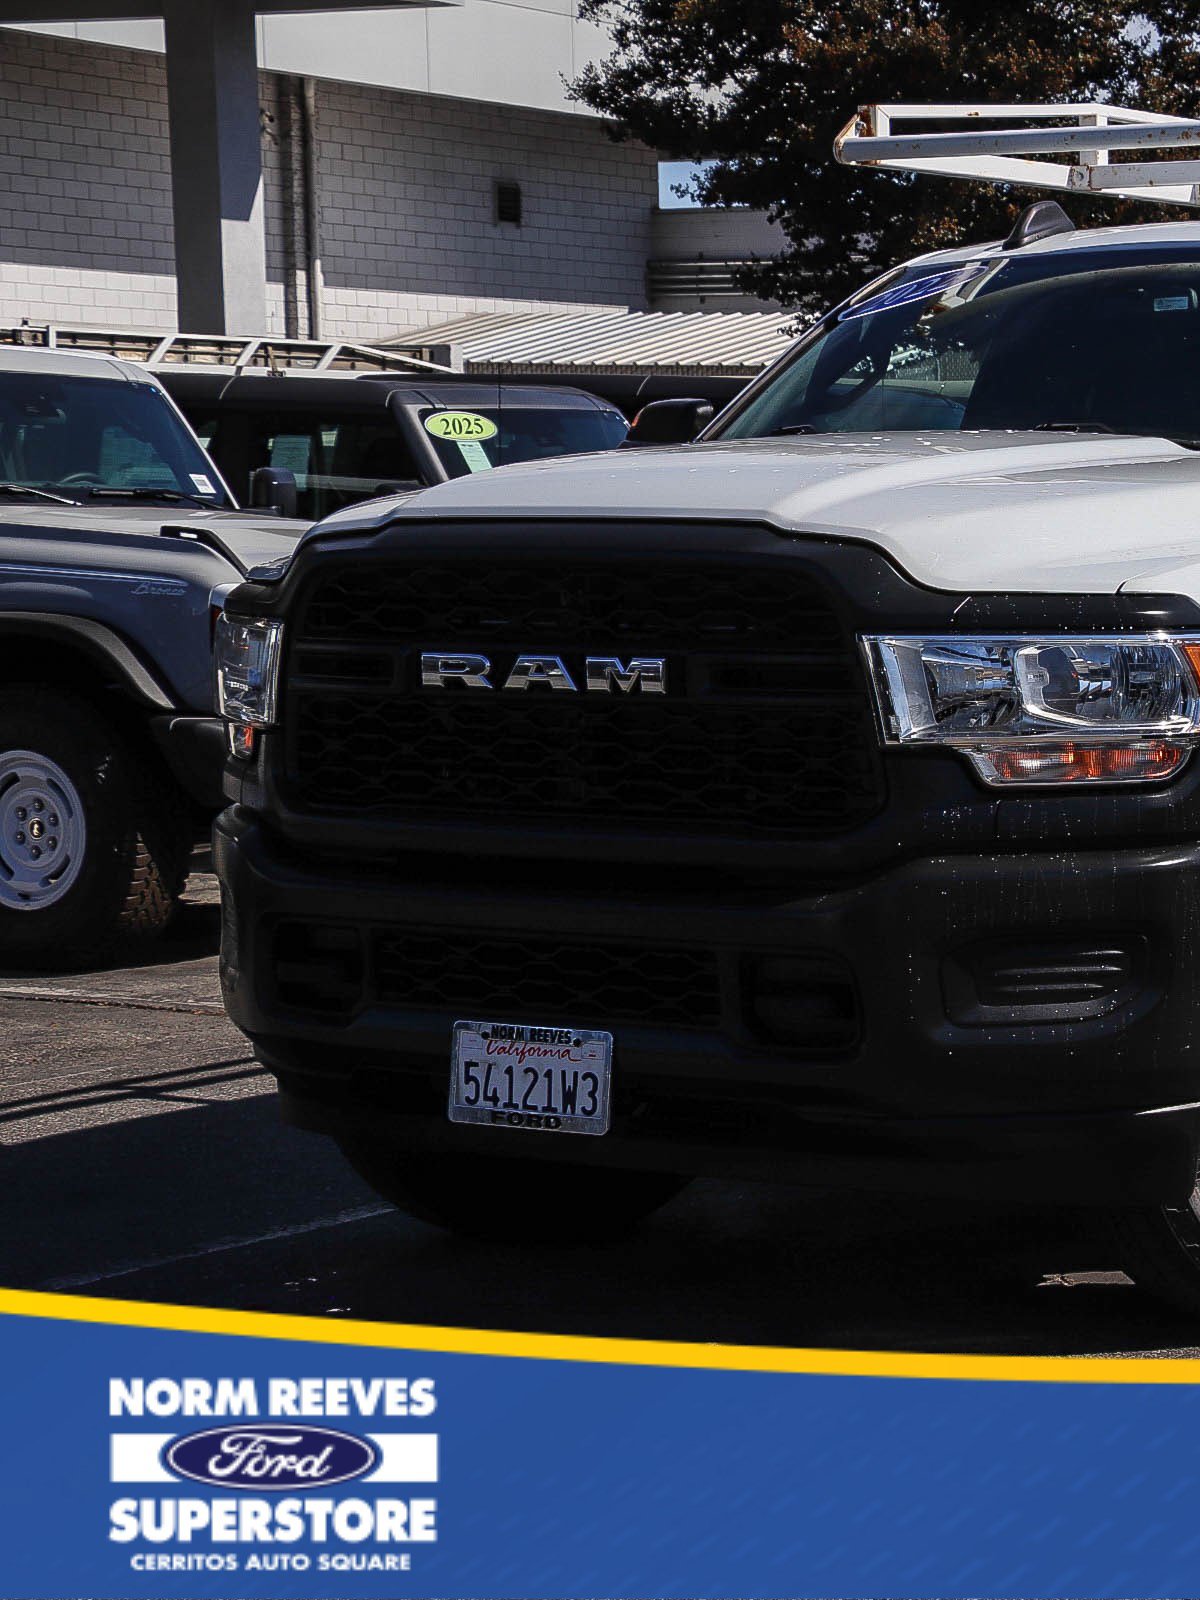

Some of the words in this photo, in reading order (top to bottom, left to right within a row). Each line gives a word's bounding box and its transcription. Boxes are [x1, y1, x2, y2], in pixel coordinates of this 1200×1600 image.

[440, 417, 483, 435] 2025
[421, 652, 666, 694] RAM
[491, 1025, 524, 1040] NORM
[530, 1029, 572, 1044] REEVES
[486, 1040, 582, 1065] California
[463, 1060, 599, 1116] 54121W3
[491, 1111, 563, 1129] FORD
